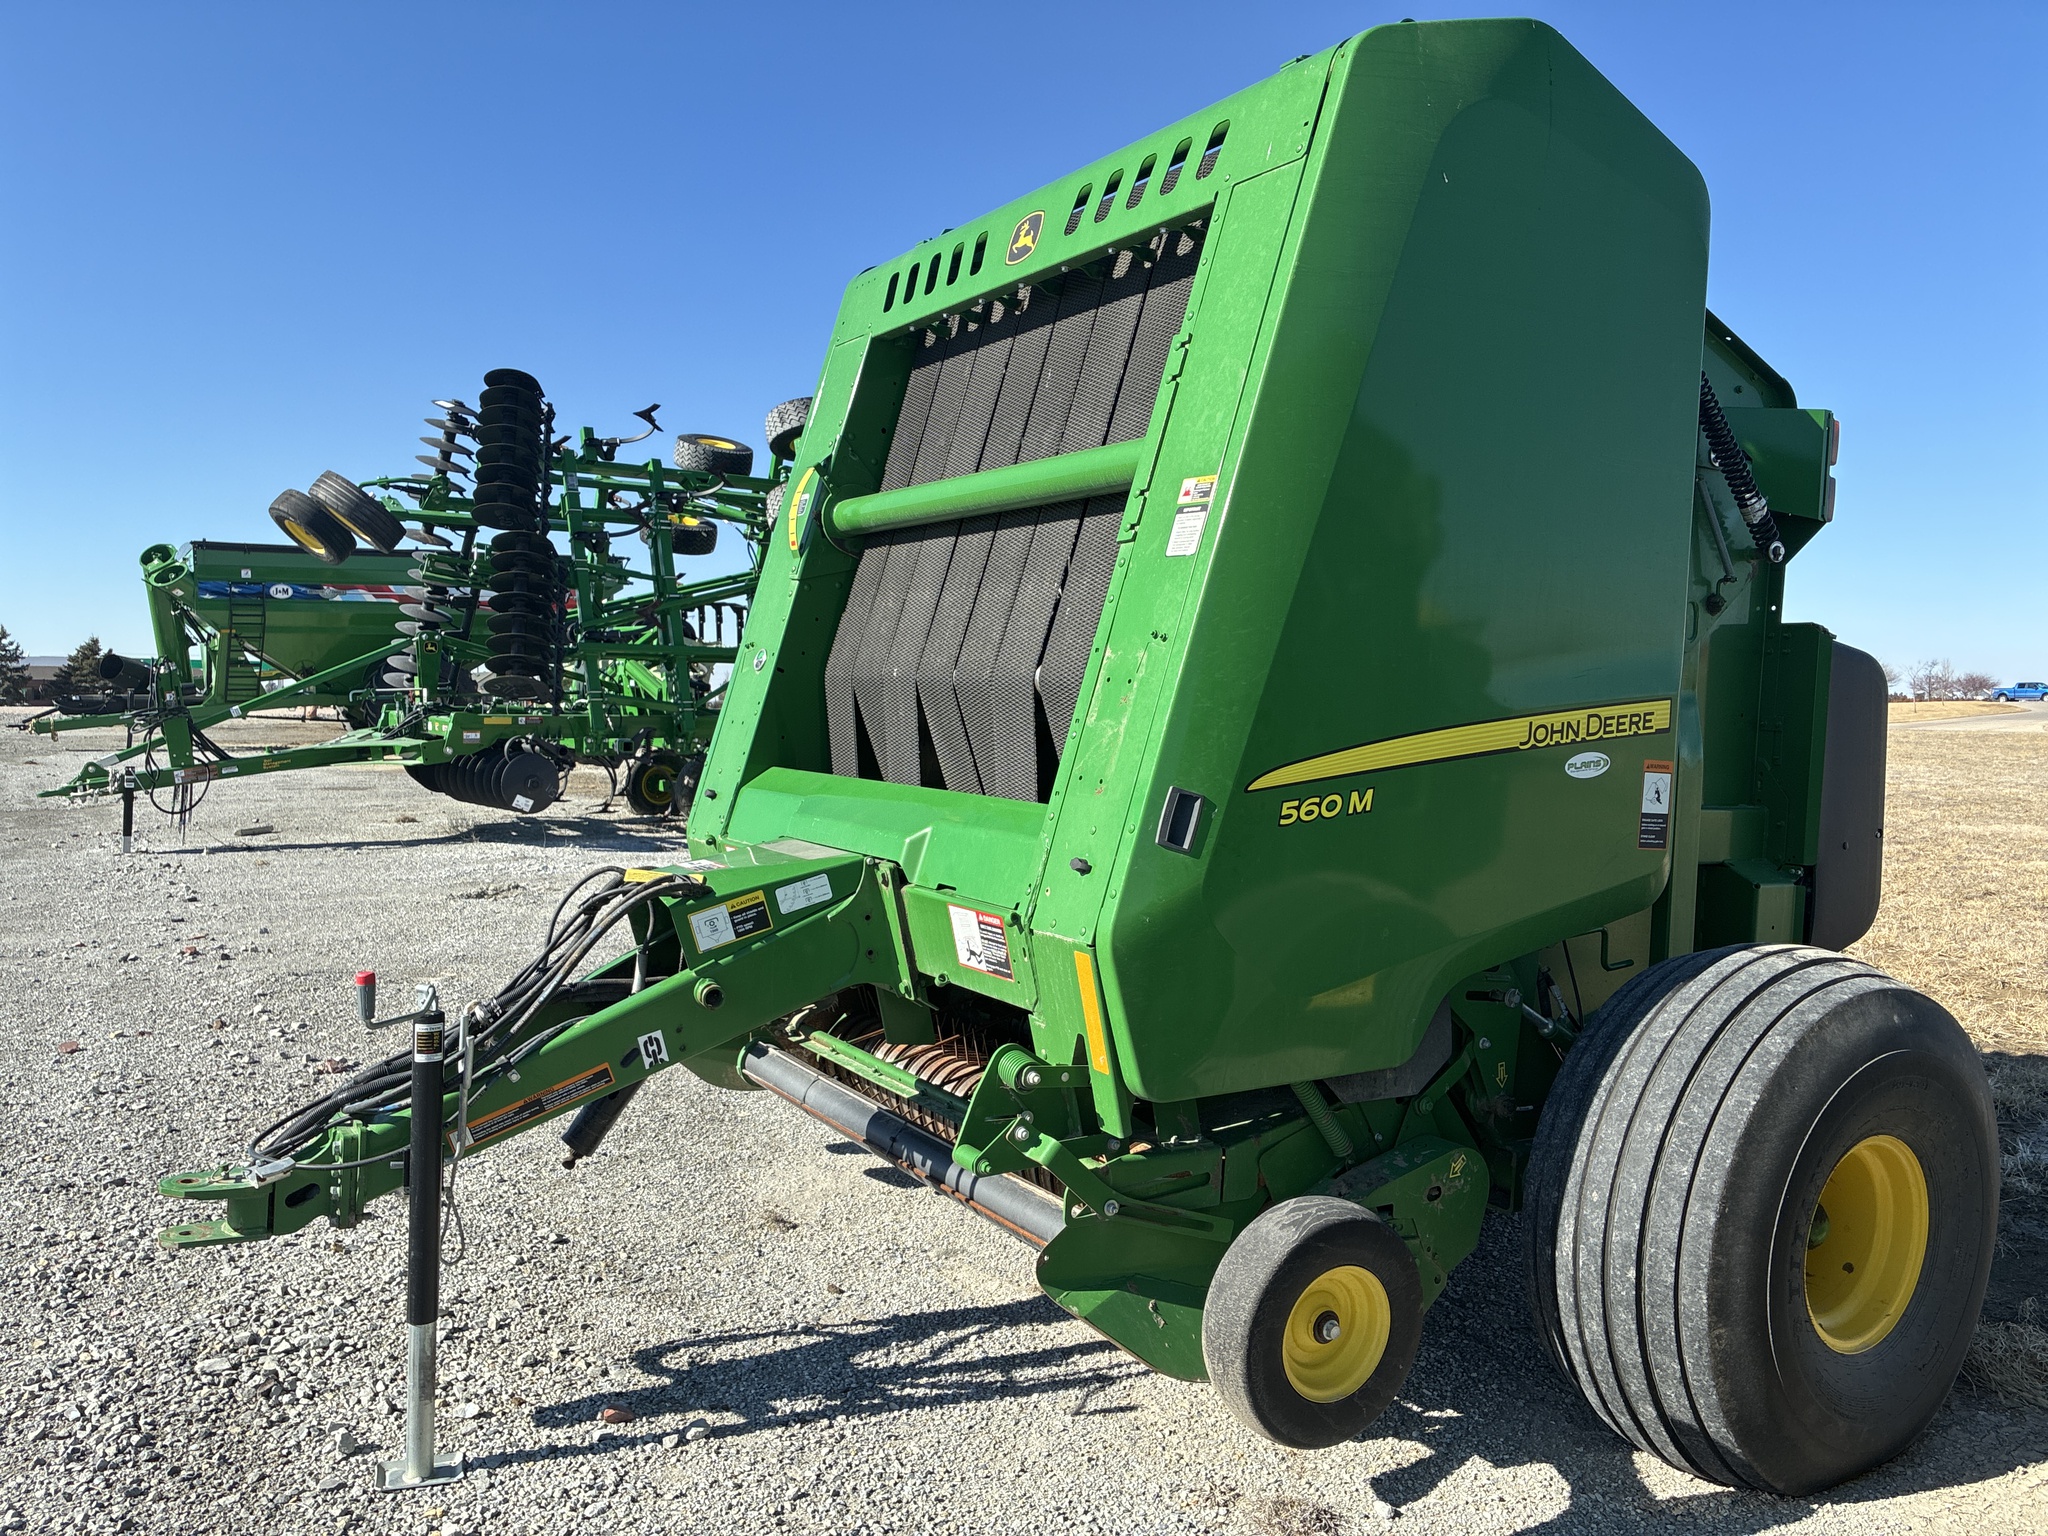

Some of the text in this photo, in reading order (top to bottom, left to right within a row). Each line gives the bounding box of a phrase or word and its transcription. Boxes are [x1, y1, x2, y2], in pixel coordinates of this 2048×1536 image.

[1519, 712, 1655, 747] JOHN DEERE
[1278, 786, 1375, 826] 560 M
[735, 895, 760, 907] CAUTION
